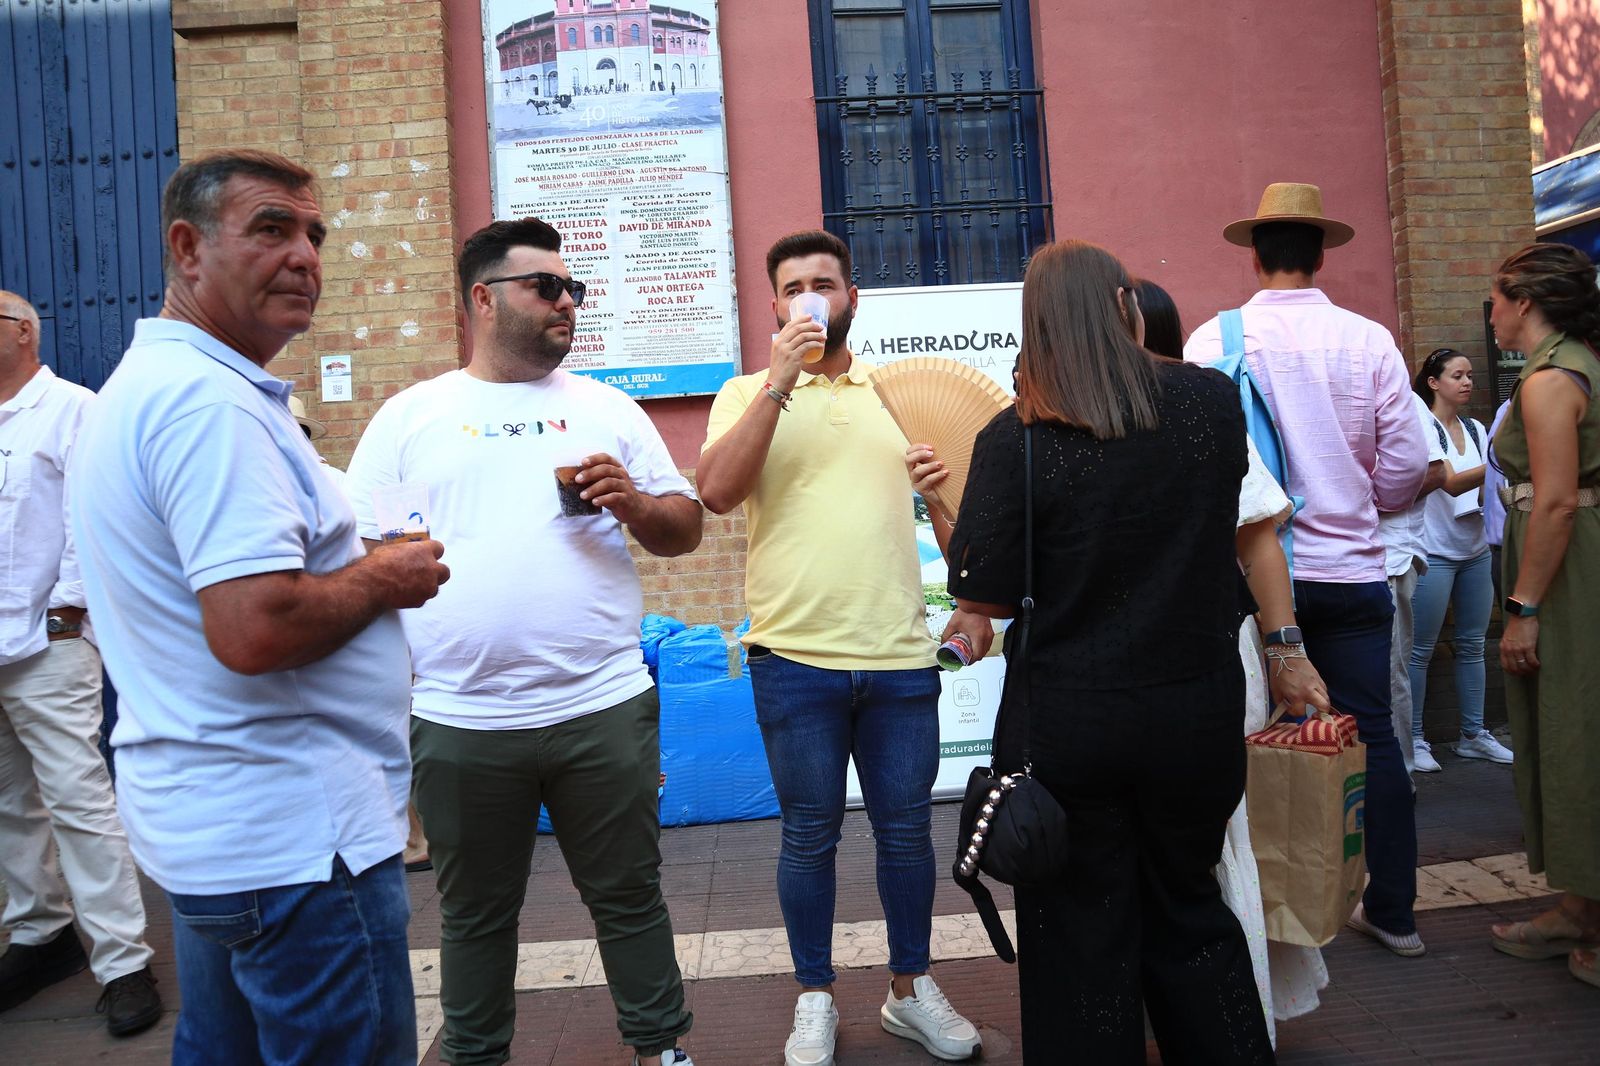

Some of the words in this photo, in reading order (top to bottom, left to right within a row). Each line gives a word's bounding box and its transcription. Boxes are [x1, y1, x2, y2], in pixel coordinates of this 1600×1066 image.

[580, 105, 605, 127] 40
[612, 116, 650, 124] HISTORIA
[586, 133, 632, 141] COMENZARÁN
[532, 147, 566, 155] MARTES
[510, 201, 557, 209] MIÉRCOLES
[556, 219, 607, 230] ZULUETA
[619, 223, 648, 232] DAVID
[666, 219, 712, 229] MIRANDA
[573, 231, 603, 240] TORO
[564, 243, 607, 253] TIRADO
[664, 270, 717, 281] TALAVANTE
[637, 285, 664, 294] JUAN
[666, 283, 704, 292] ORTEGA
[647, 296, 674, 305] ROCA
[677, 295, 695, 303] REY
[623, 316, 723, 325] WWW.TOROSPEREDA.COM
[850, 340, 875, 356] LA
[880, 330, 1019, 354] HERRADURA
[605, 375, 629, 384] CAJA
[632, 373, 664, 383] RURAL
